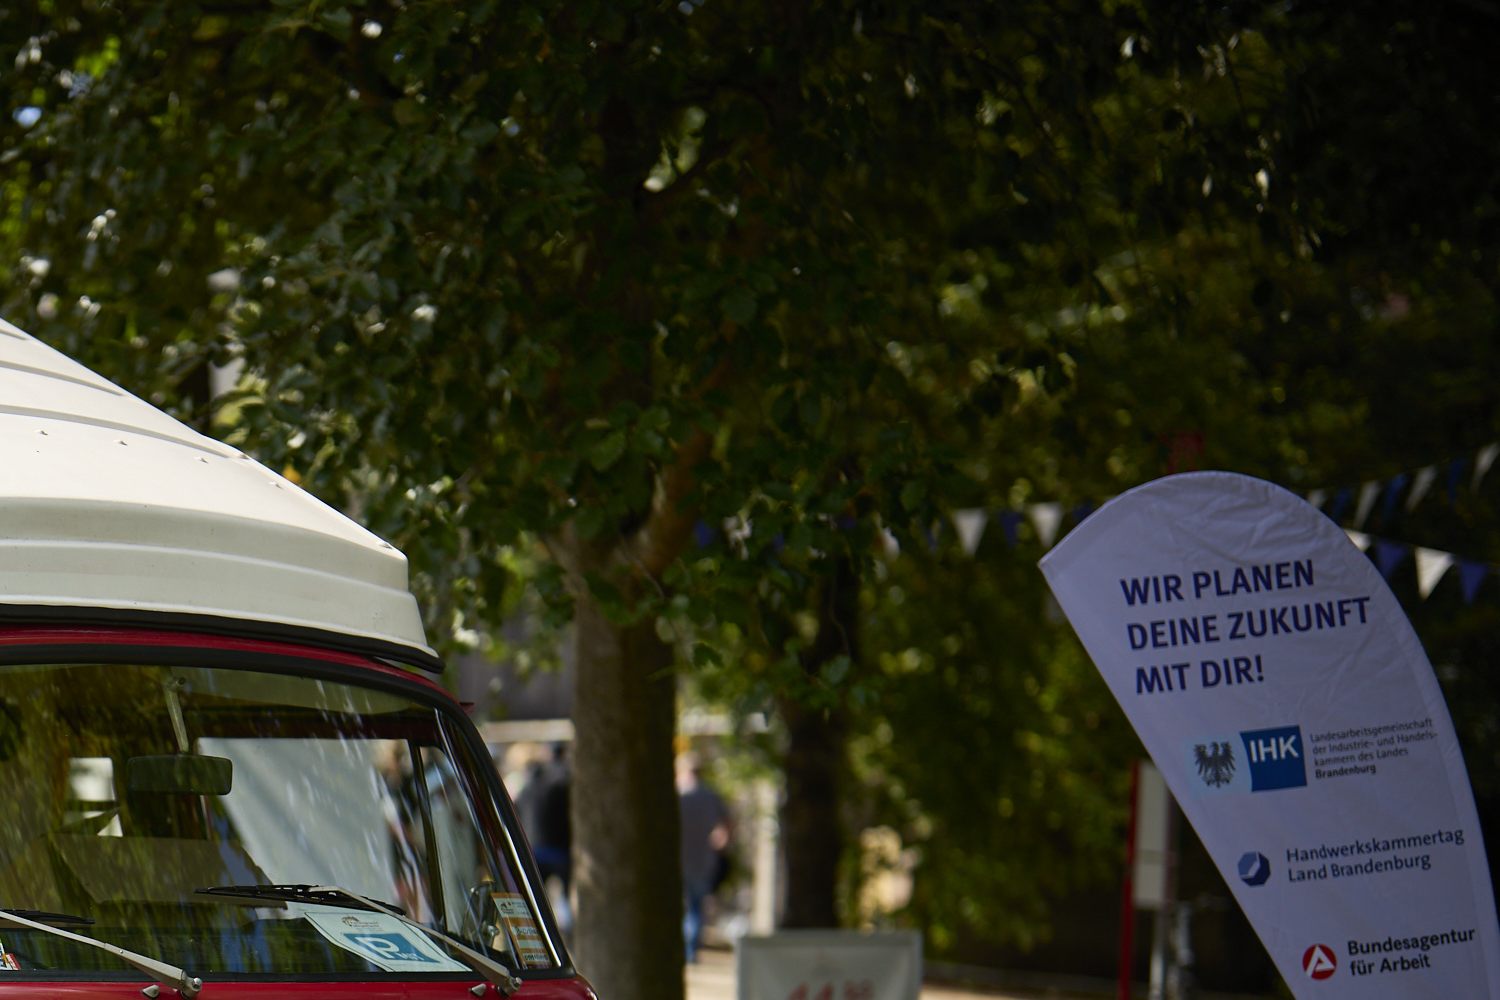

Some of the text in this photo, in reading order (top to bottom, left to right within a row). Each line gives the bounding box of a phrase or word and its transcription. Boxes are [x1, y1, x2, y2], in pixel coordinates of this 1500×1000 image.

[1120, 559, 1314, 606] WIR PLANEN
[1127, 596, 1370, 650] DEINE ZUKUNFT
[1135, 655, 1264, 694] MIT DIR!
[1310, 717, 1433, 743] Landesarbeitsgemeinschaft
[1313, 730, 1438, 755] der Industrie- und Handels-
[1250, 735, 1299, 763] IHK
[1314, 747, 1409, 766] kammern des Landes
[1315, 764, 1377, 779] Brandenburg
[1286, 829, 1464, 863] Handwerkskammertag
[1288, 854, 1431, 882] Land Brandenburg
[1347, 928, 1476, 955] Bundesagentur
[1350, 954, 1431, 976] für Arbeit
